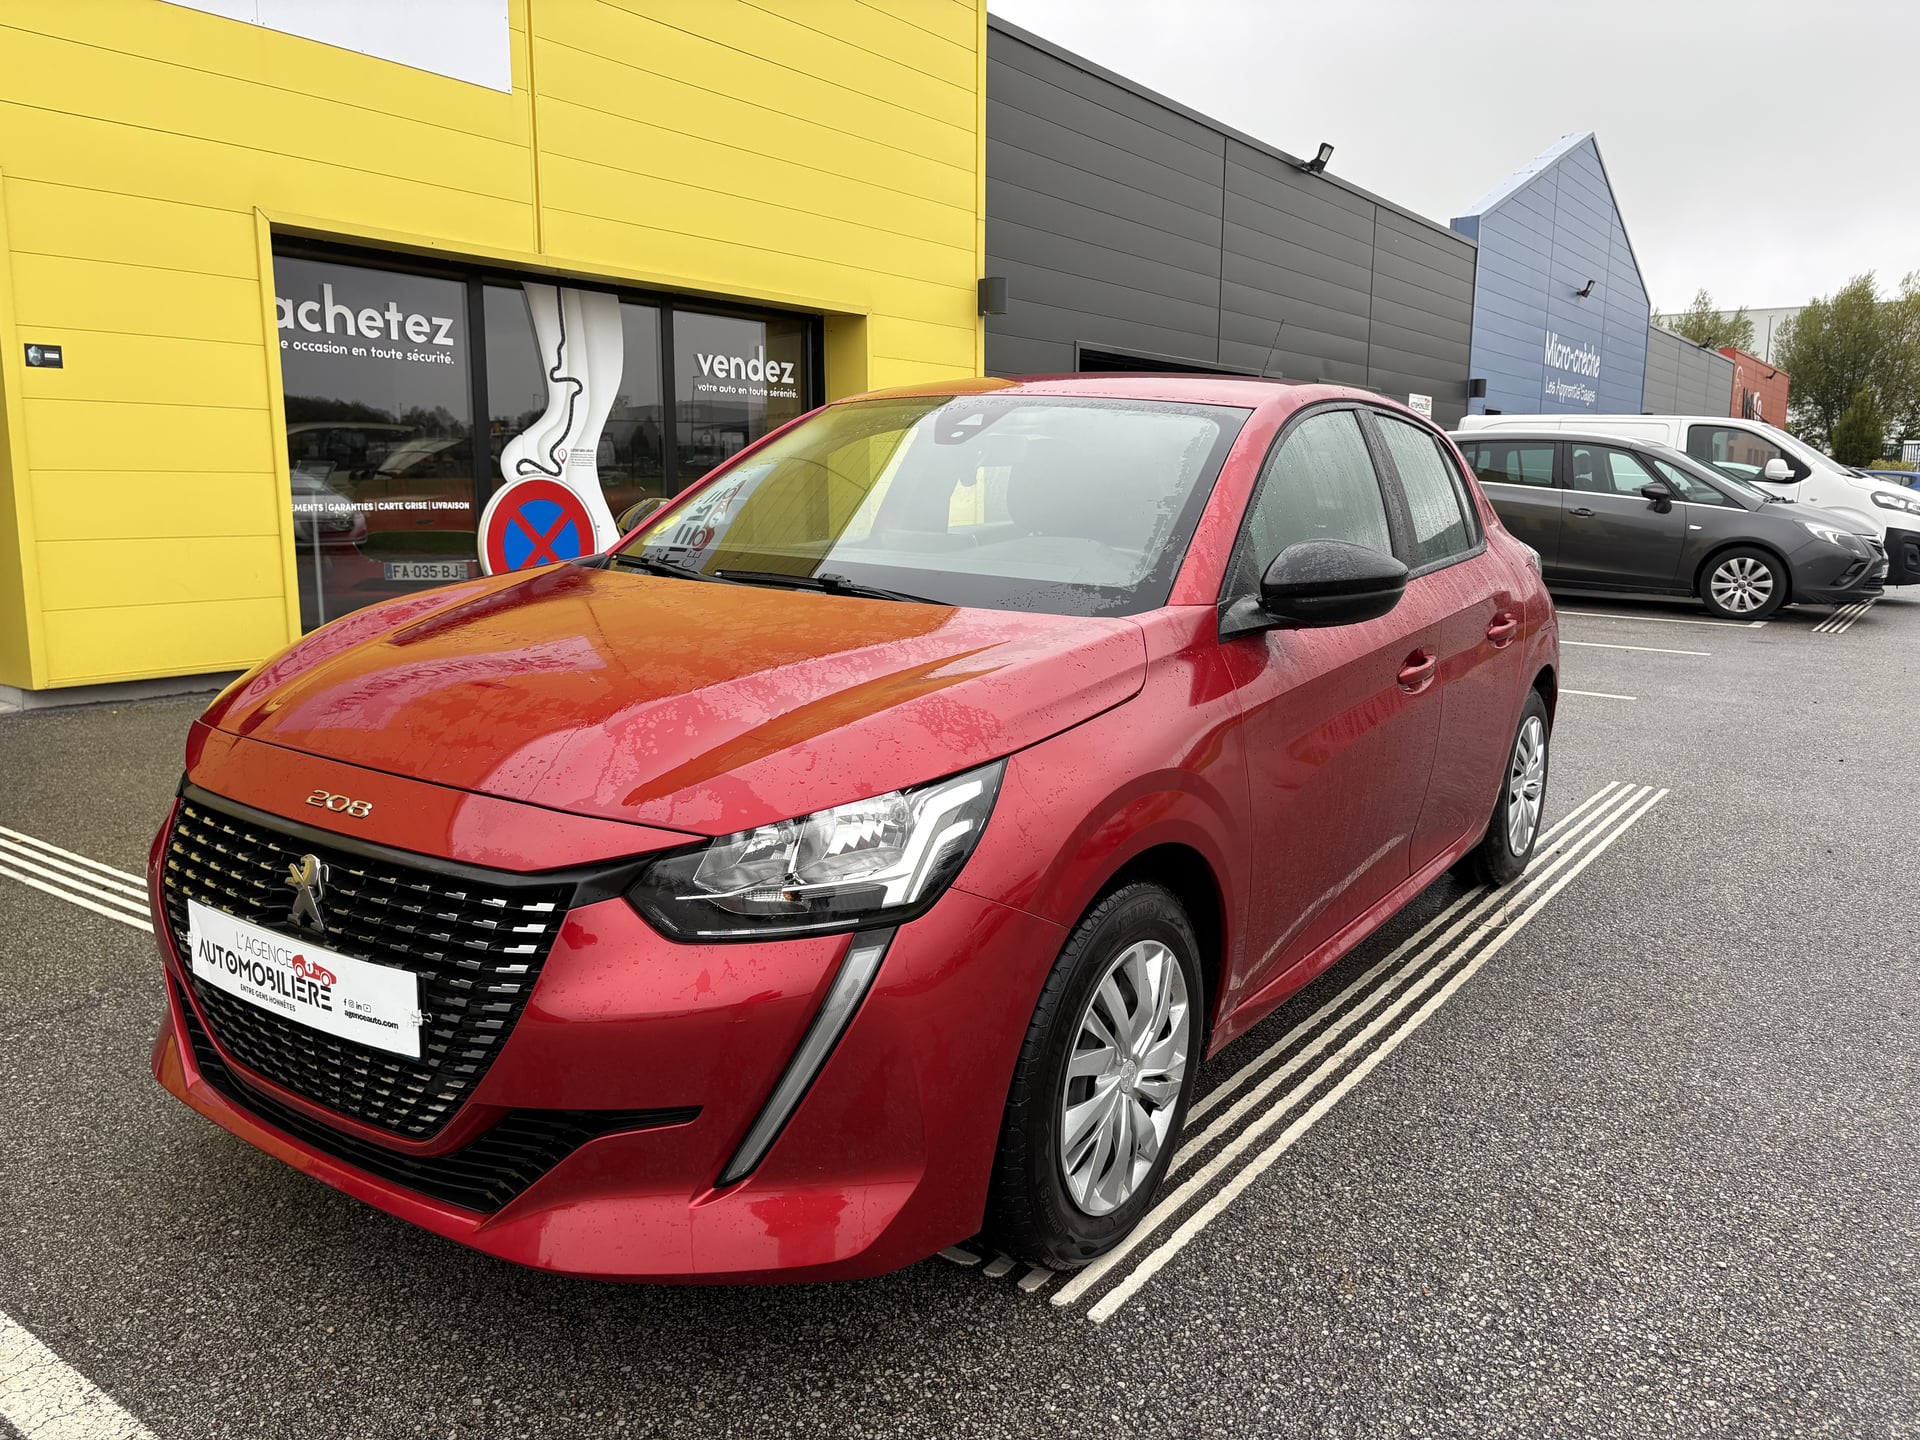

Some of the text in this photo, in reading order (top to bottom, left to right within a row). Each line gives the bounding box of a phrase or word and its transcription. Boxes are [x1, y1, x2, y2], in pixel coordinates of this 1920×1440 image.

[293, 340, 348, 355] occasion
[352, 347, 367, 357] en
[371, 346, 403, 361] toute
[407, 349, 455, 365] sécurité.
[697, 345, 794, 384] vendez
[697, 383, 799, 399] votre auto en toute sérénité.
[328, 503, 374, 512] GARANTIES
[377, 502, 404, 511] CARTE
[405, 501, 428, 510] GRISE
[431, 501, 470, 510] LIVRAISON
[305, 789, 373, 818] 208
[236, 930, 294, 969] L'AGENCE
[240, 984, 255, 996] ENTRE
[255, 990, 268, 1002] GENS
[344, 1010, 399, 1030] agenceauto.com
